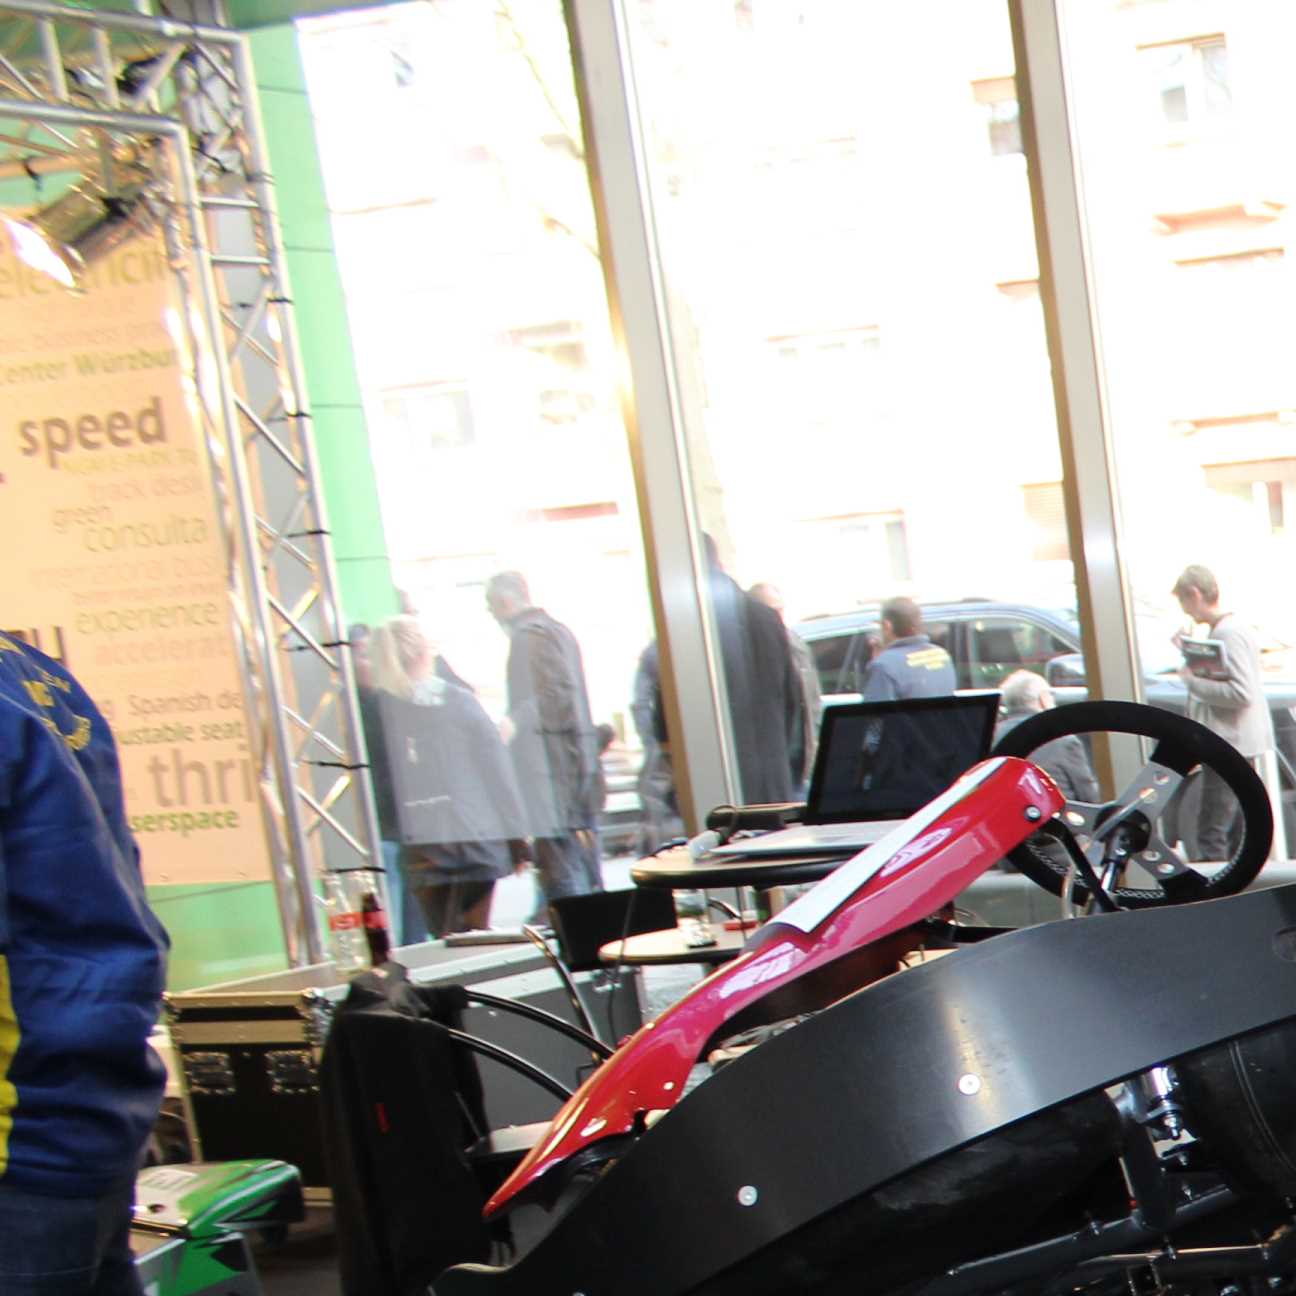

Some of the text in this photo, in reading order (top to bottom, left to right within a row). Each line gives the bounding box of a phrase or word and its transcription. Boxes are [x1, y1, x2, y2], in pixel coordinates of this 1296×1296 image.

[18, 395, 167, 470] speed
[75, 601, 220, 638] experience
[128, 691, 211, 721] Spanish
[129, 810, 240, 839] serspace
